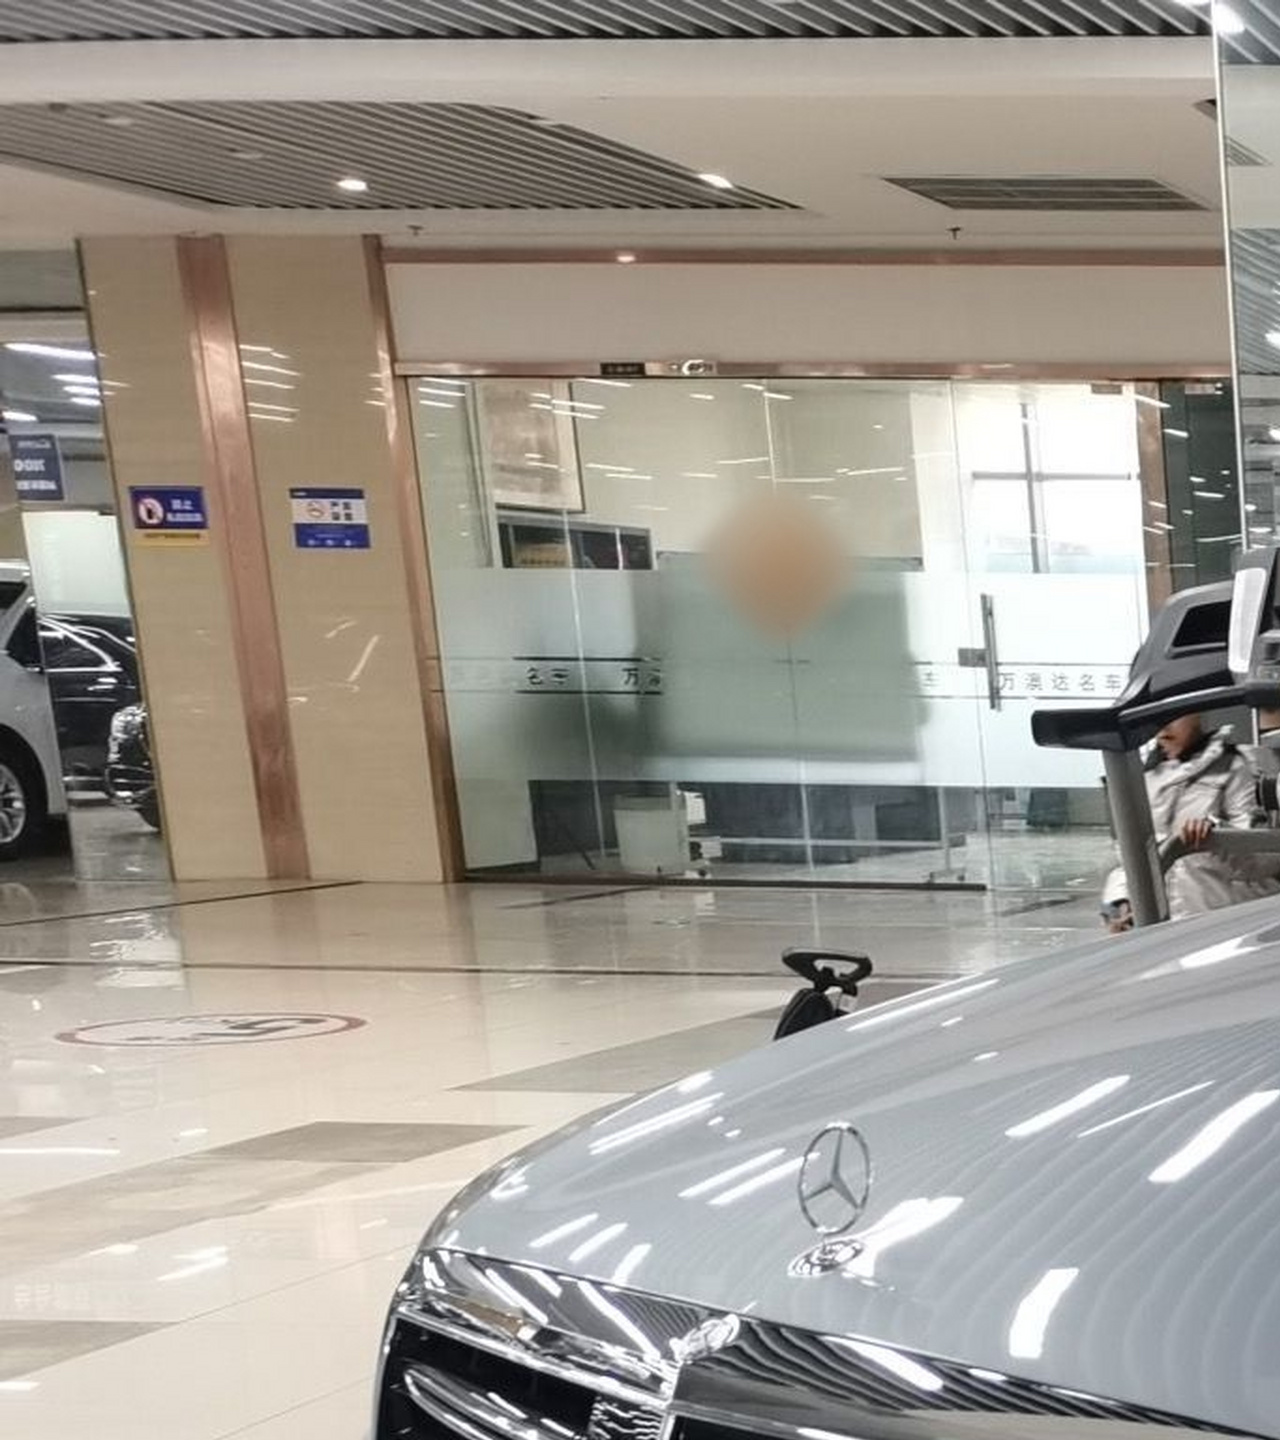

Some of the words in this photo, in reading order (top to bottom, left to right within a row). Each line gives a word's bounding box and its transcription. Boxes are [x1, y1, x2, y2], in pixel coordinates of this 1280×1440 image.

[998, 672, 1122, 692] 万澳达名车
